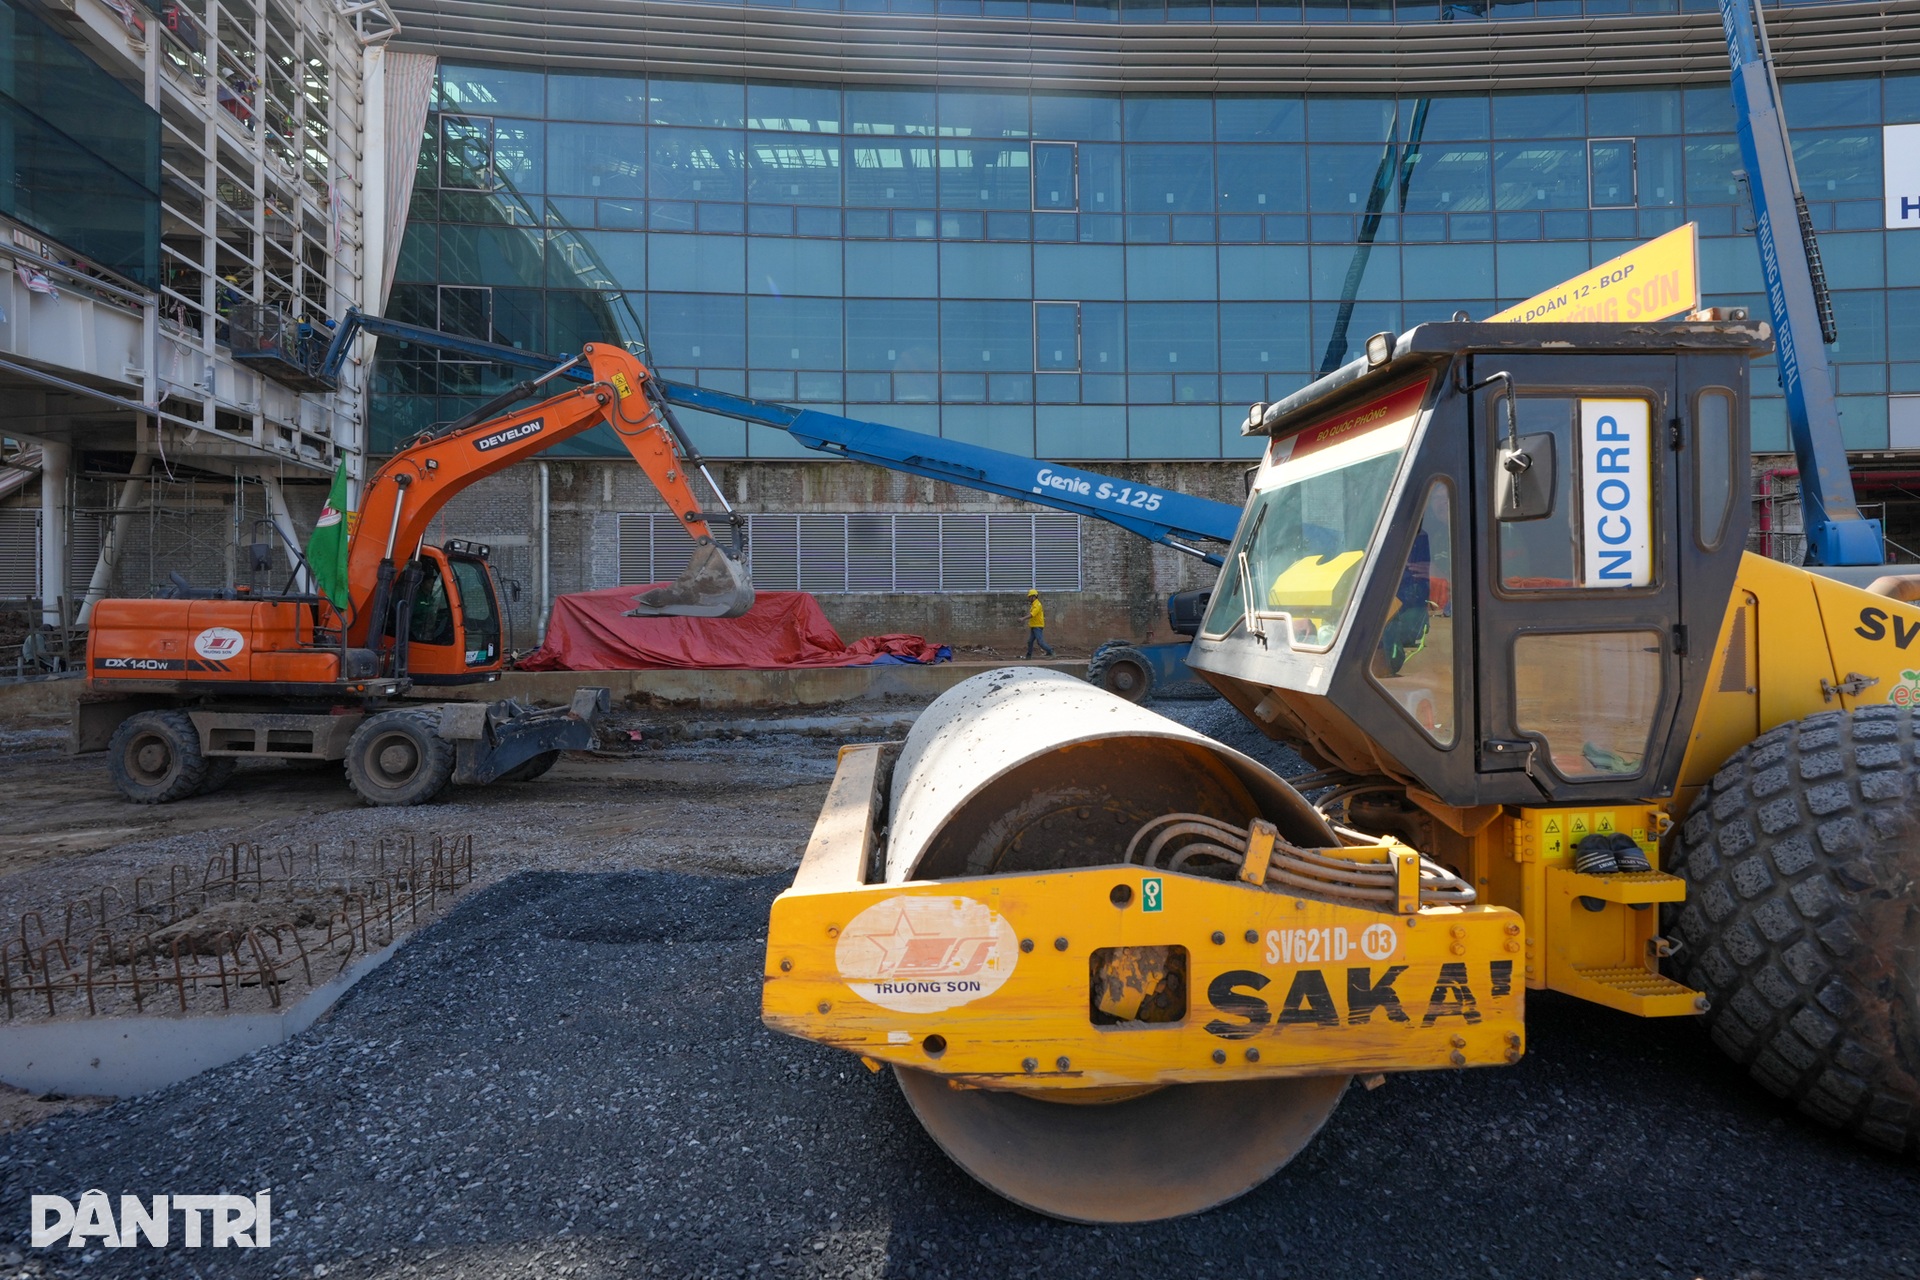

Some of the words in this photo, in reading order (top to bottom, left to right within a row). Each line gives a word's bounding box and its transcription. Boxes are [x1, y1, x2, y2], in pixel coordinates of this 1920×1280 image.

[1572, 285, 1589, 300] 12
[1600, 264, 1634, 289] BQP
[1757, 210, 1778, 284] PHUONG
[1771, 282, 1785, 322] ANH
[1778, 321, 1799, 394] RENTAL
[479, 421, 541, 450] DEVELON
[1095, 482, 1163, 511] S-125
